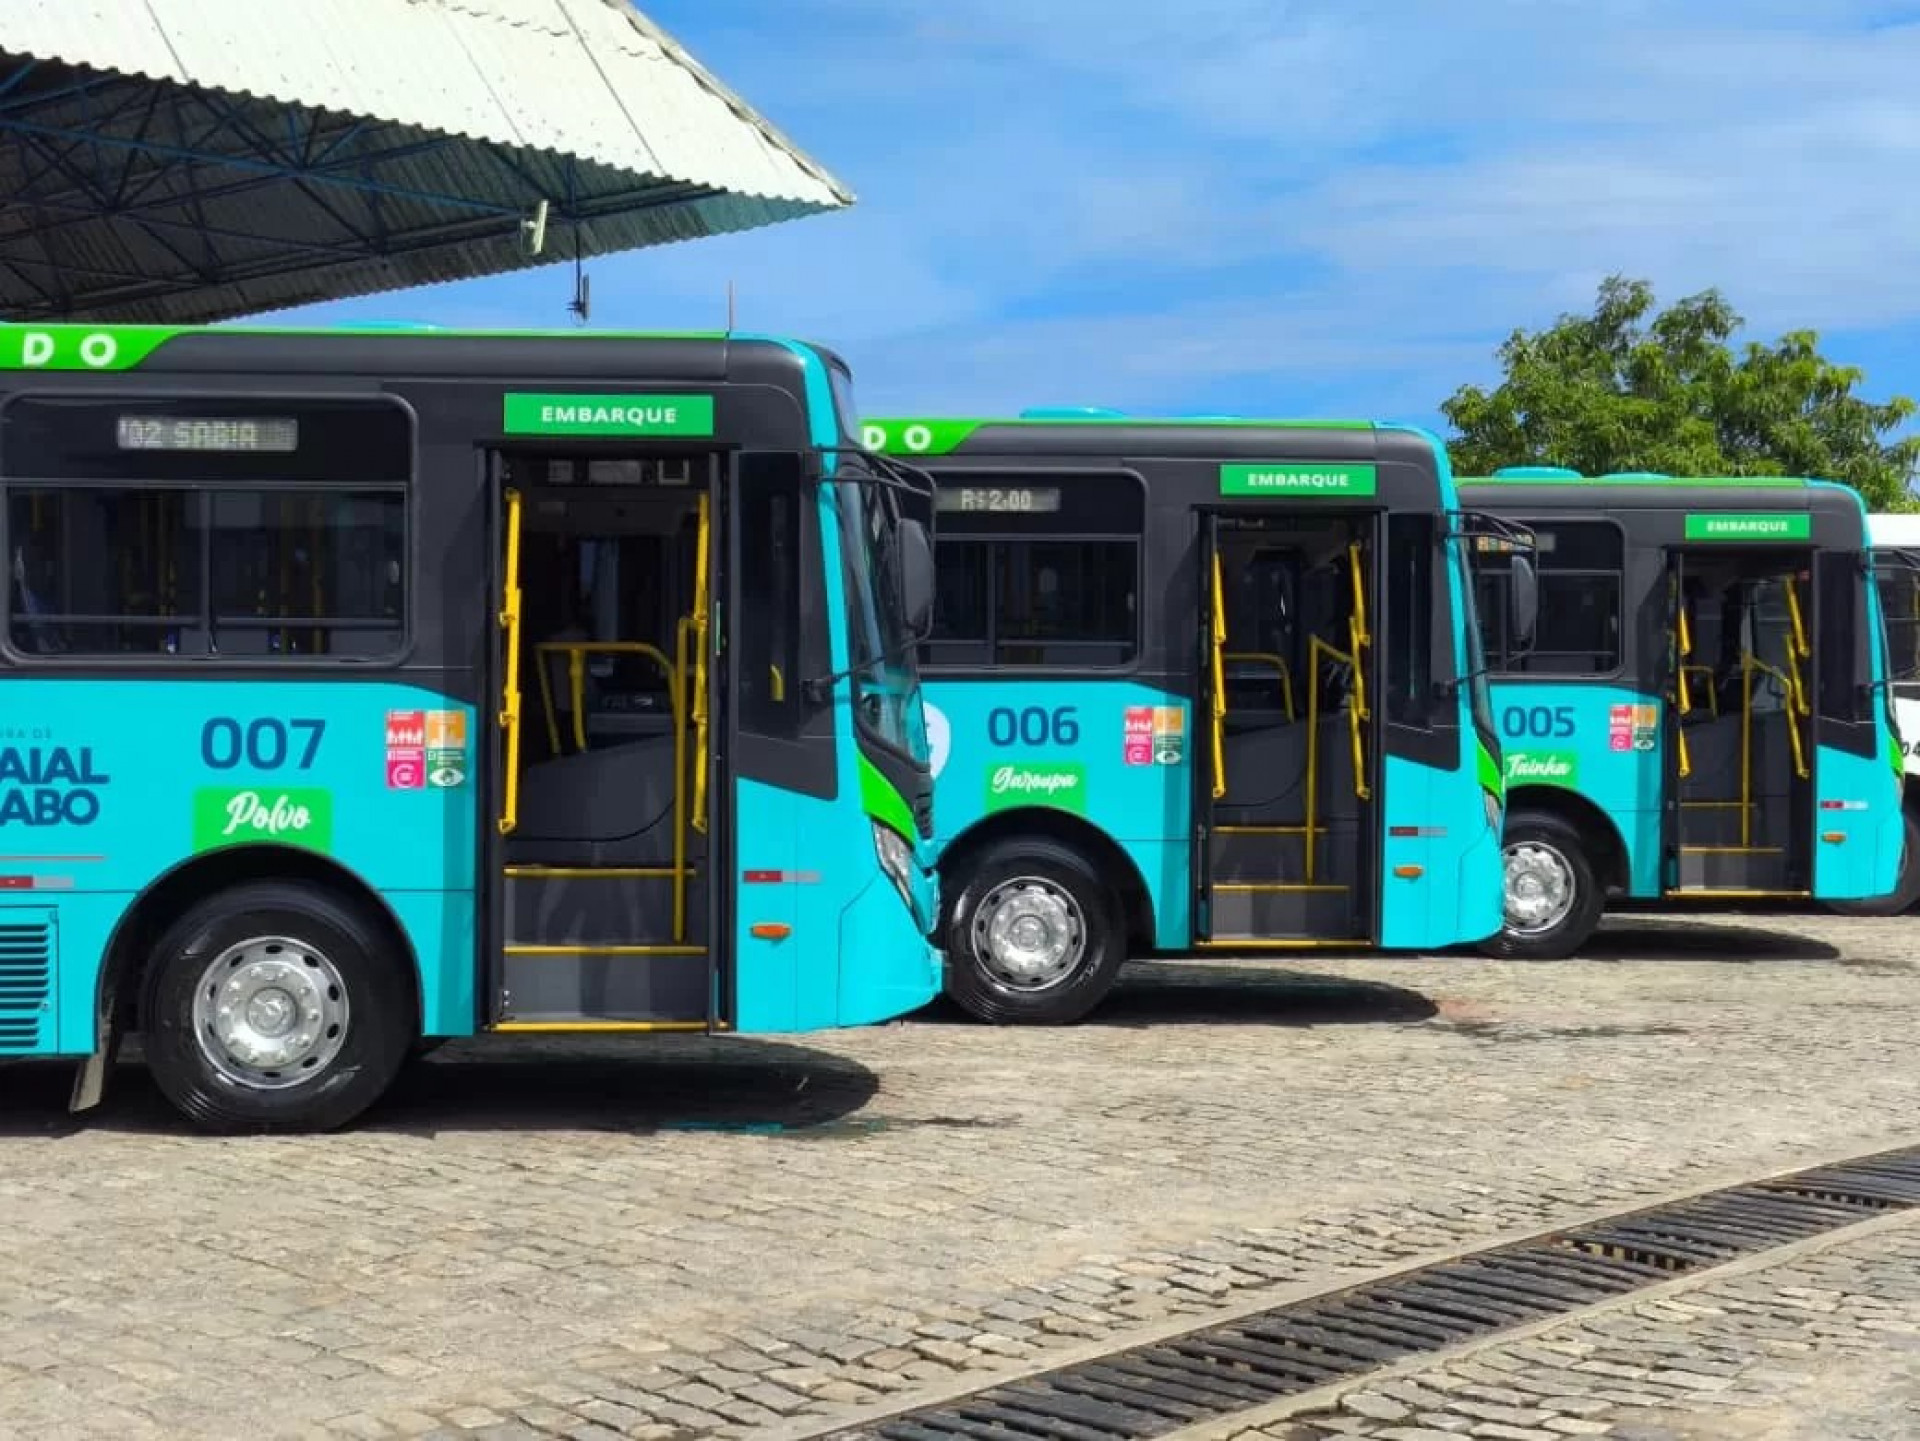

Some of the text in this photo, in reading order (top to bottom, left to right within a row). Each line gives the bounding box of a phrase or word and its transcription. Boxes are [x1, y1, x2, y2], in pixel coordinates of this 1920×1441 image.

[541, 405, 678, 426] EMBARQUE
[1247, 473, 1349, 488] EMBARQUE
[1707, 521, 1788, 533] EMBARQUE
[988, 706, 1079, 747] 006
[1502, 705, 1576, 738] 005
[202, 717, 326, 770] 007
[0, 747, 110, 785] AIAL
[993, 766, 1077, 795] Garoupa
[1506, 753, 1570, 778] Tainha
[0, 789, 99, 826] ABO
[222, 791, 311, 835] Polvo
